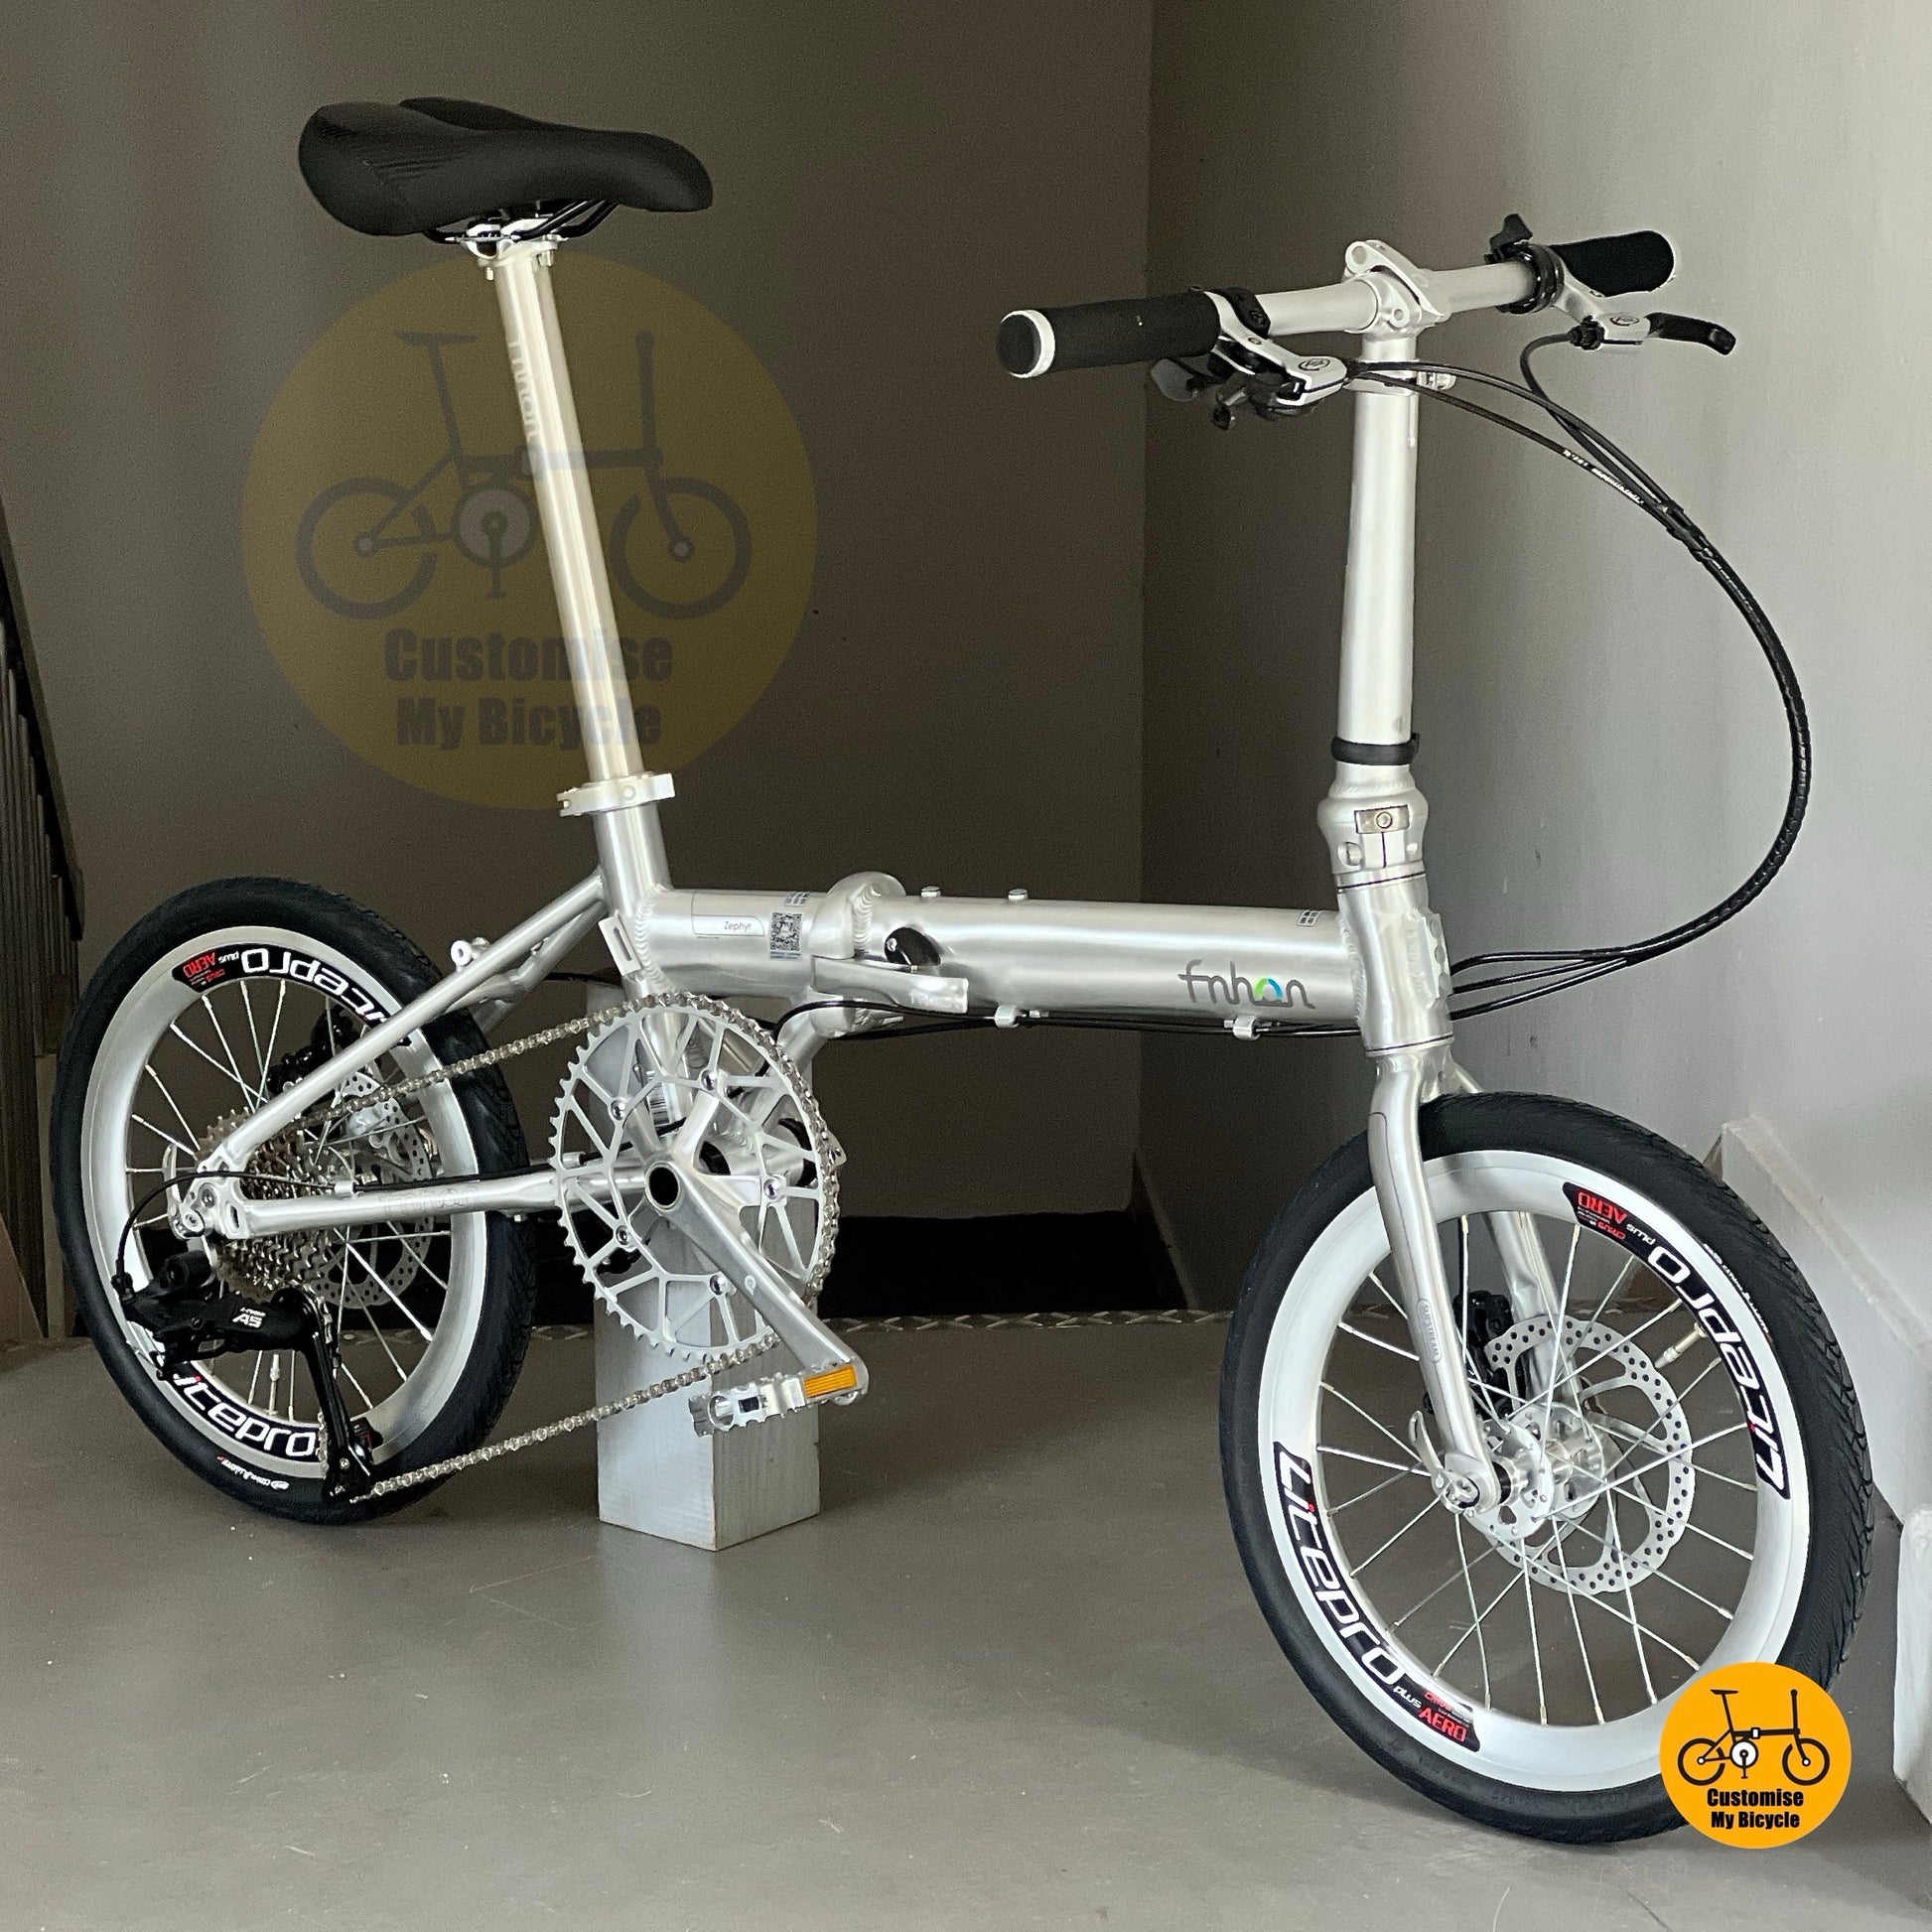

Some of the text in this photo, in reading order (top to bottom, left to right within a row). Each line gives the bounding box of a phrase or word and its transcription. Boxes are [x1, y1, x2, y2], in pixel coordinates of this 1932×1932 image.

[724, 920, 752, 932] Zephyr
[240, 947, 387, 1023] itepro
[1177, 959, 1316, 1010] fnhon
[1578, 1191, 1628, 1225] AERO
[1626, 1223, 1656, 1245] plus
[1647, 1245, 1785, 1490] Litepro
[173, 1373, 316, 1457] itepro
[1279, 1450, 1423, 1709] Litepro plus
[1419, 1707, 1467, 1742] AERO
